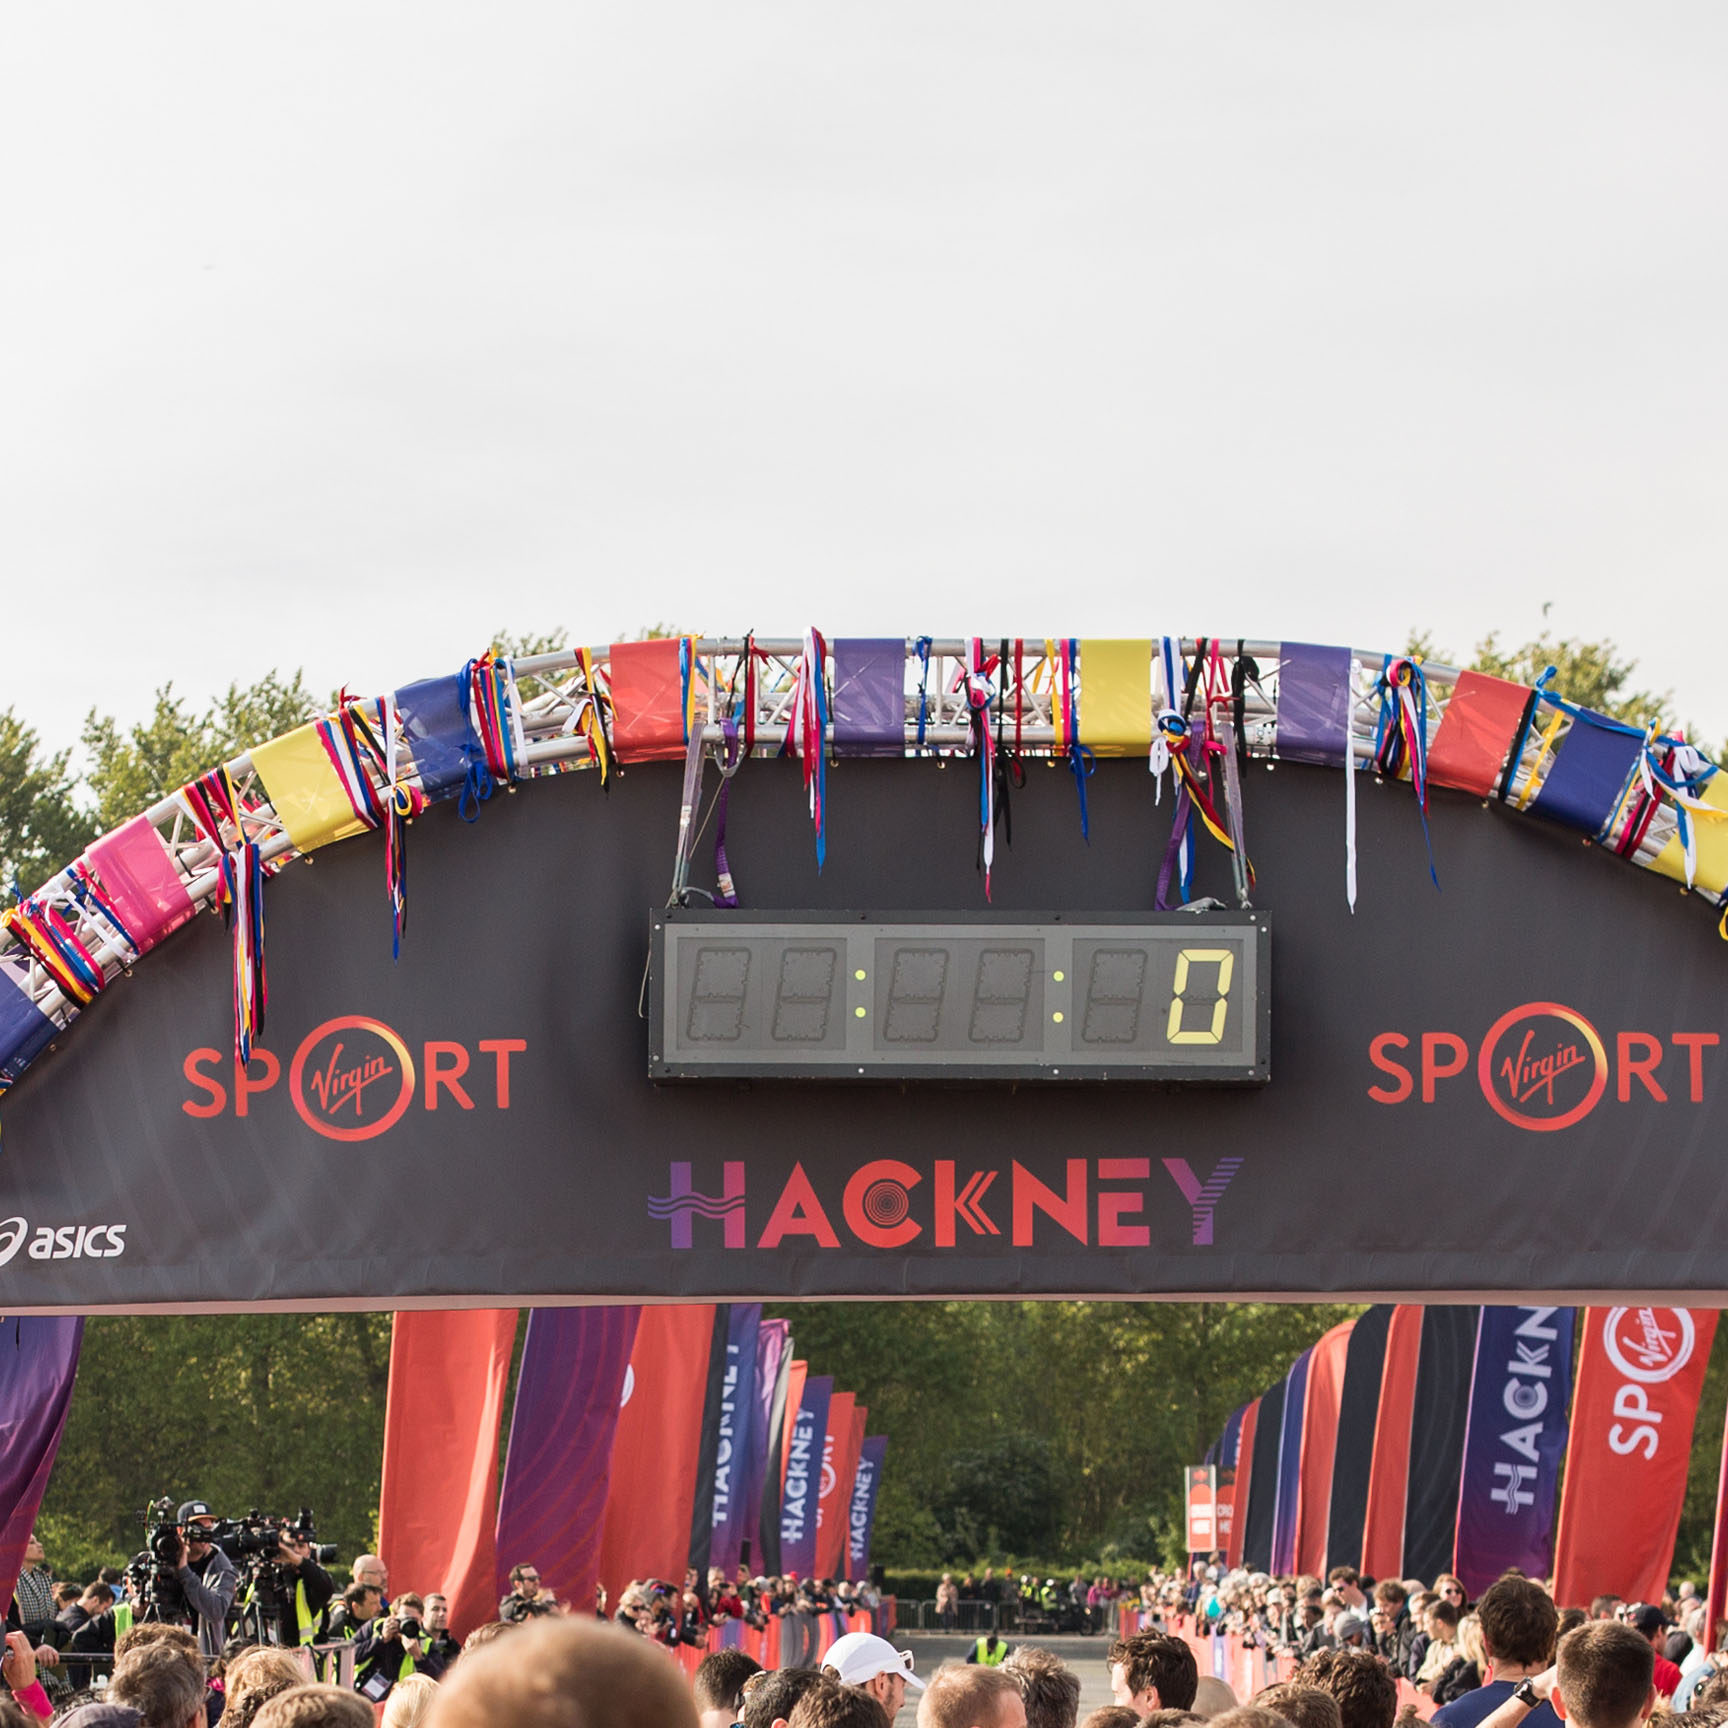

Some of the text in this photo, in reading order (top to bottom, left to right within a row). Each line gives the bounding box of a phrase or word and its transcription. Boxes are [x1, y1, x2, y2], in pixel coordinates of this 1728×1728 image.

[310, 1043, 393, 1117] Virgin
[1500, 1029, 1586, 1105] Virgin
[647, 1156, 1246, 1249] HACKNEY
[780, 1408, 815, 1544] HACKNEY
[850, 1457, 875, 1561] HACKNEY
